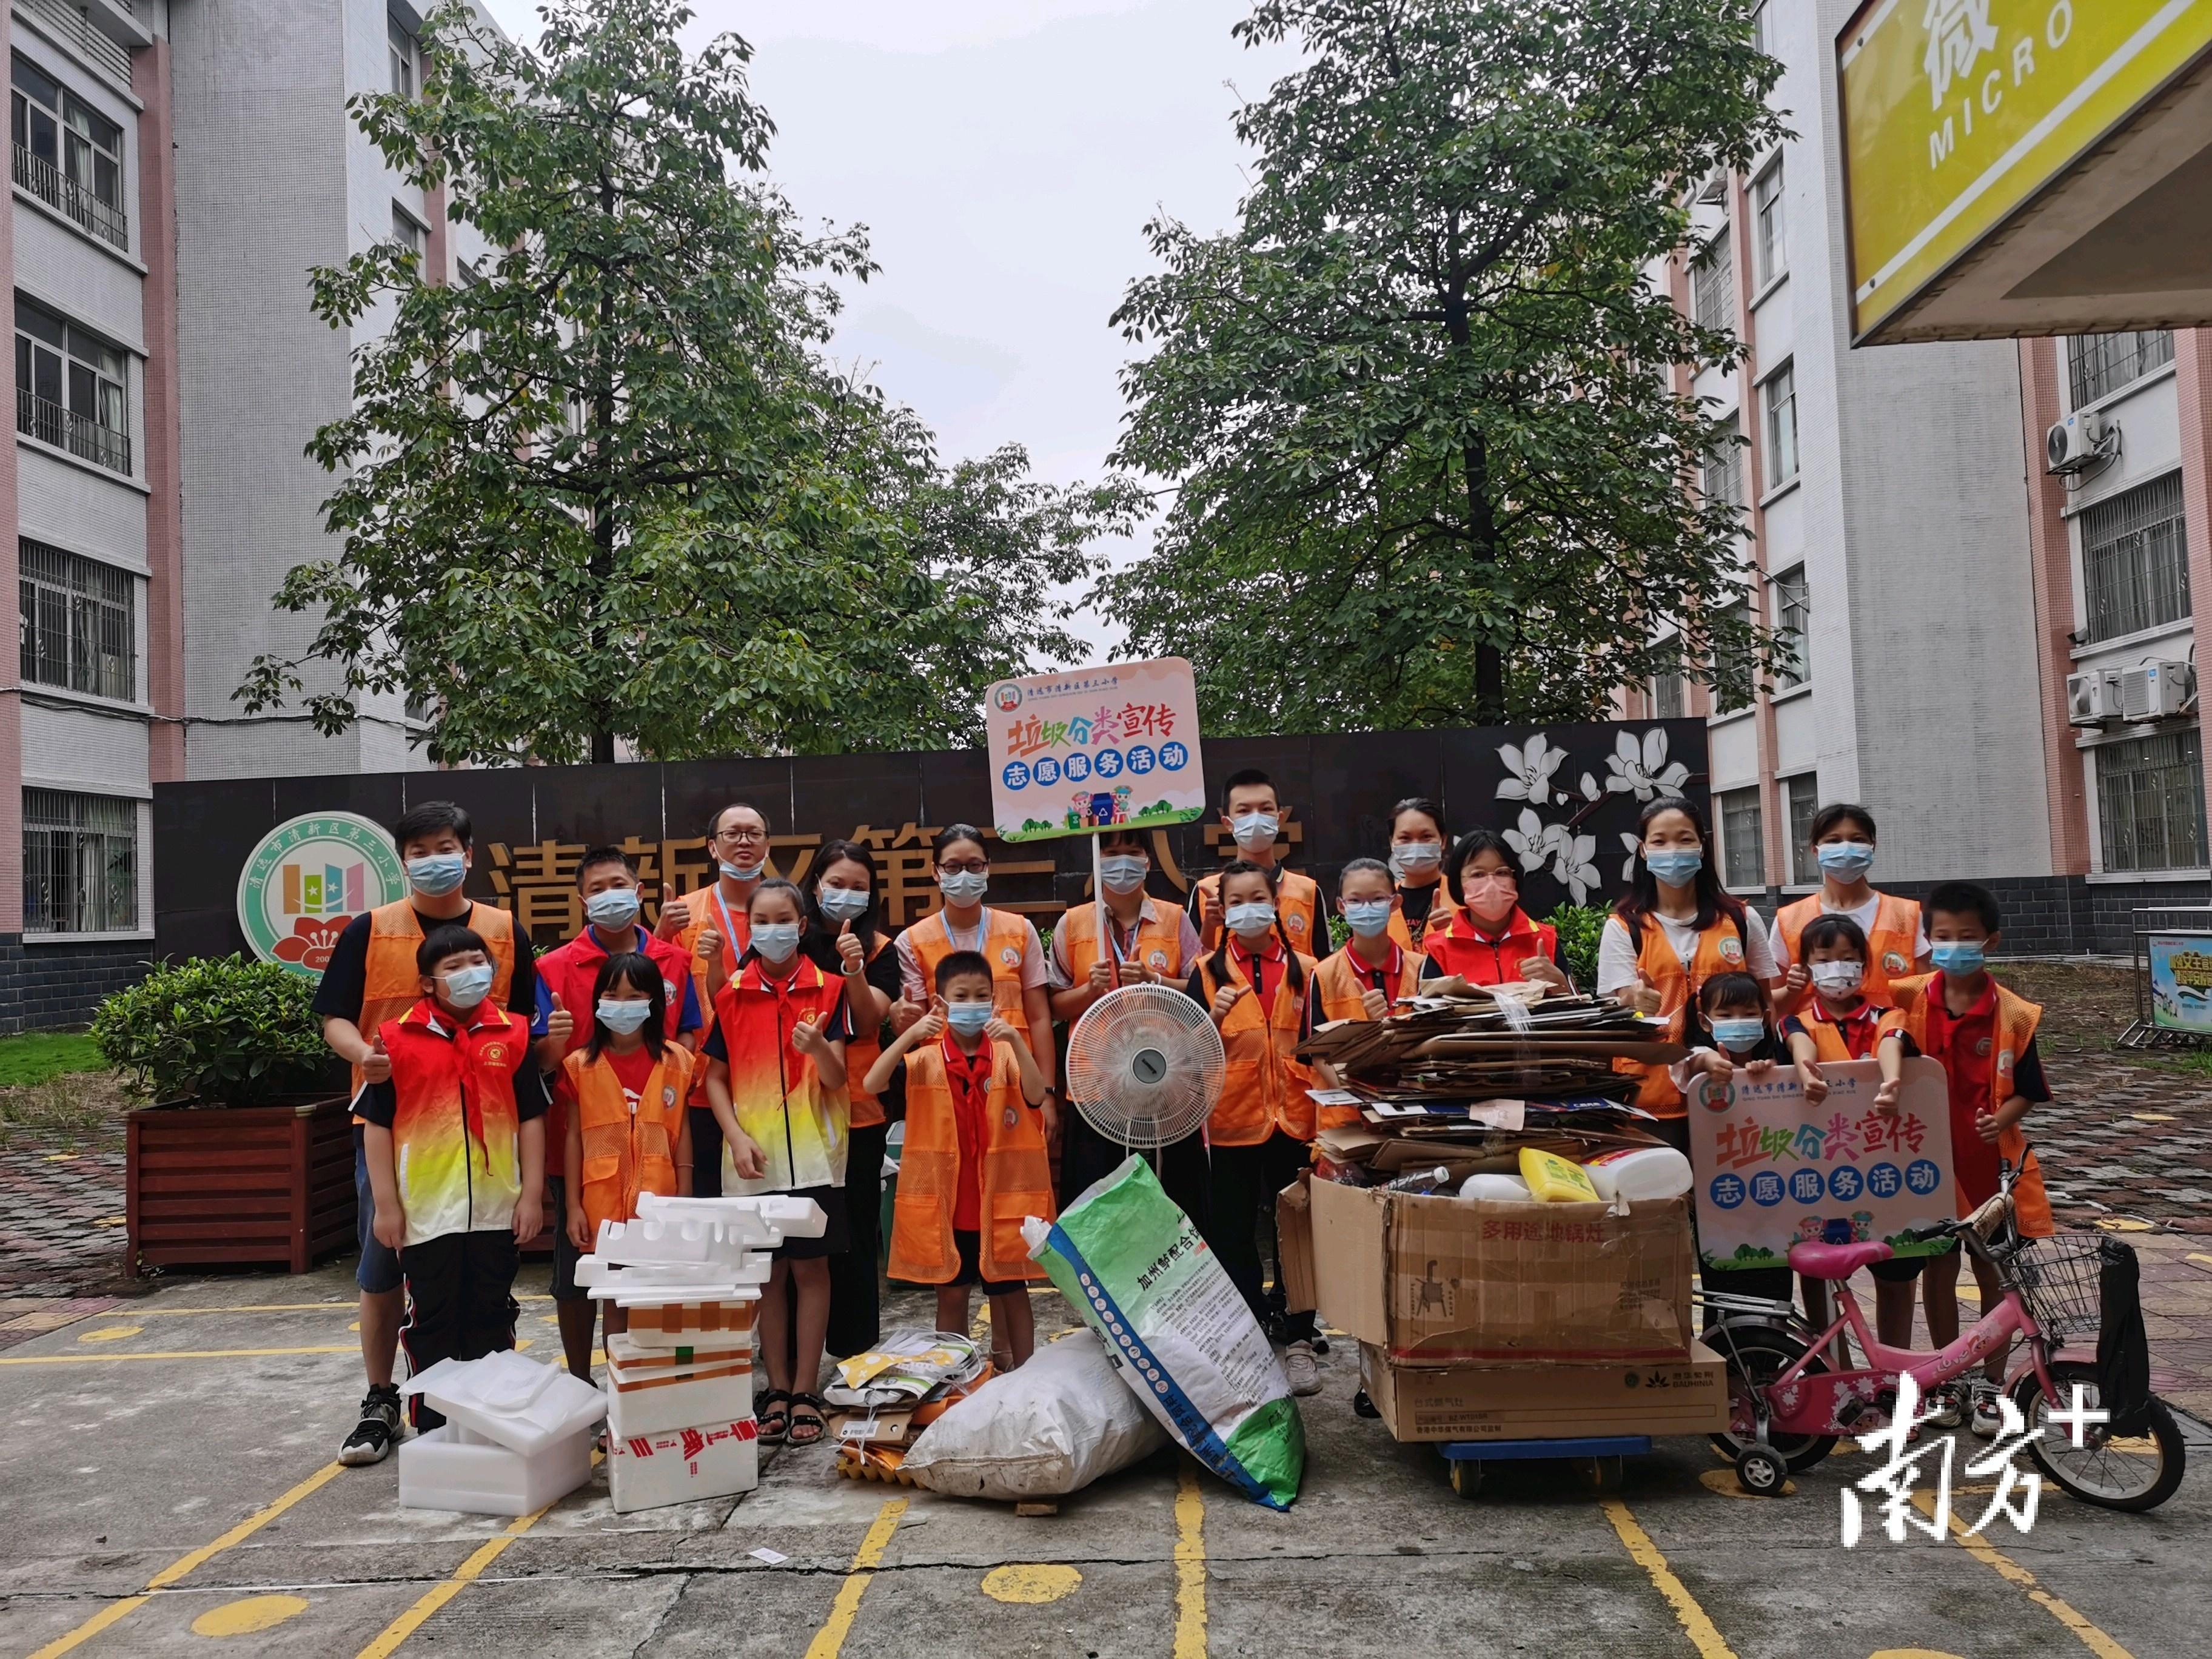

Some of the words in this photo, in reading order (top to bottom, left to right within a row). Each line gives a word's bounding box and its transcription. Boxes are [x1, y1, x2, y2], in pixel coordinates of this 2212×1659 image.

[1929, 0, 2073, 170] MICRO
[1007, 702, 1176, 758] 垃圾分类宣传
[1006, 743, 1185, 786] 志愿服务活动
[1715, 1108, 1928, 1170] 垃圾分类宣传
[1715, 1162, 1937, 1204] 志愿服务活动
[1483, 1219, 1606, 1244] 多用途地锅灶
[1672, 1379, 1714, 1388] BAUHINIA
